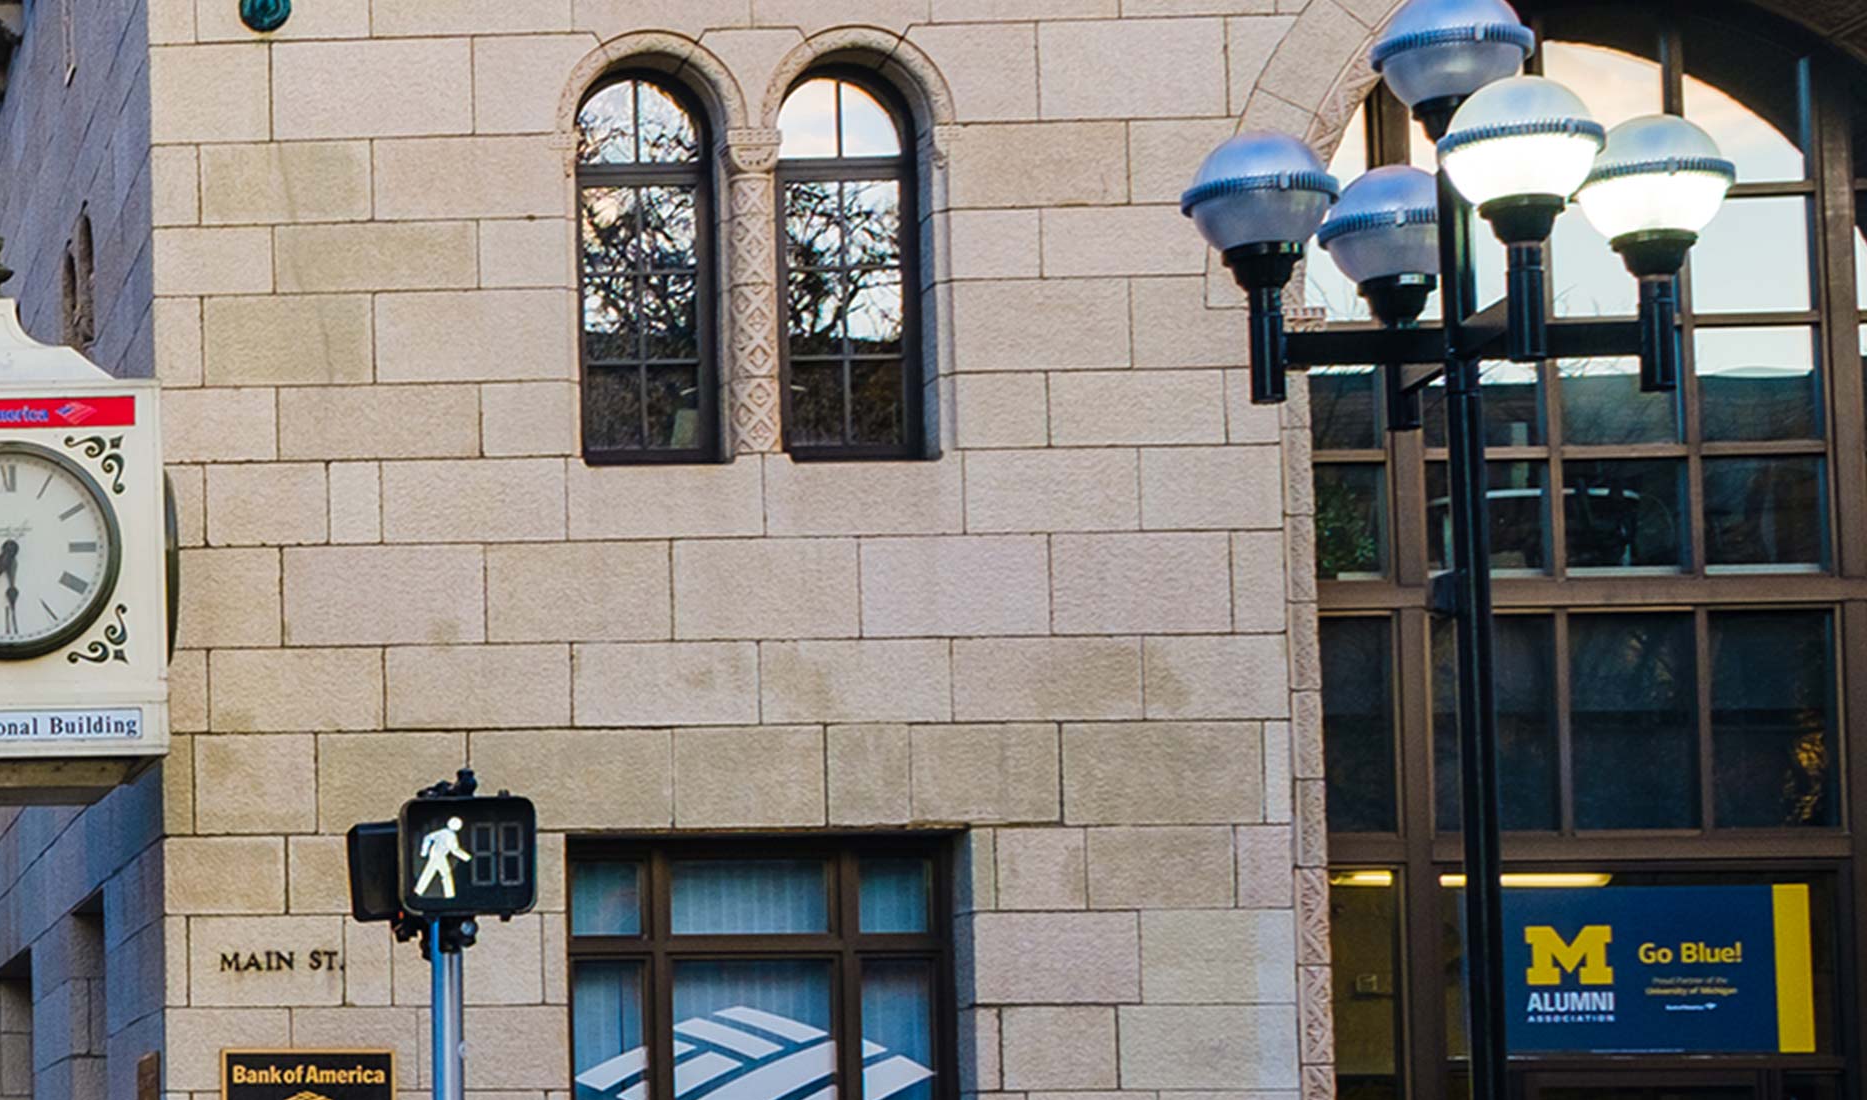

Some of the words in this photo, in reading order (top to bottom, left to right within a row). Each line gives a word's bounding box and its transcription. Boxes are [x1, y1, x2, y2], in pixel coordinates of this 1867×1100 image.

[50, 715, 138, 738] Building
[220, 951, 295, 972] MAIN
[308, 950, 345, 971] ST.
[1524, 925, 1614, 986] M
[1638, 941, 1673, 964] Go
[1680, 940, 1742, 964] Blue!
[1526, 992, 1615, 1012] ALUMNI
[1527, 1014, 1615, 1023] ASSOCIATION
[232, 1064, 282, 1084] Bank
[283, 1064, 305, 1084] of
[305, 1064, 386, 1084] America
